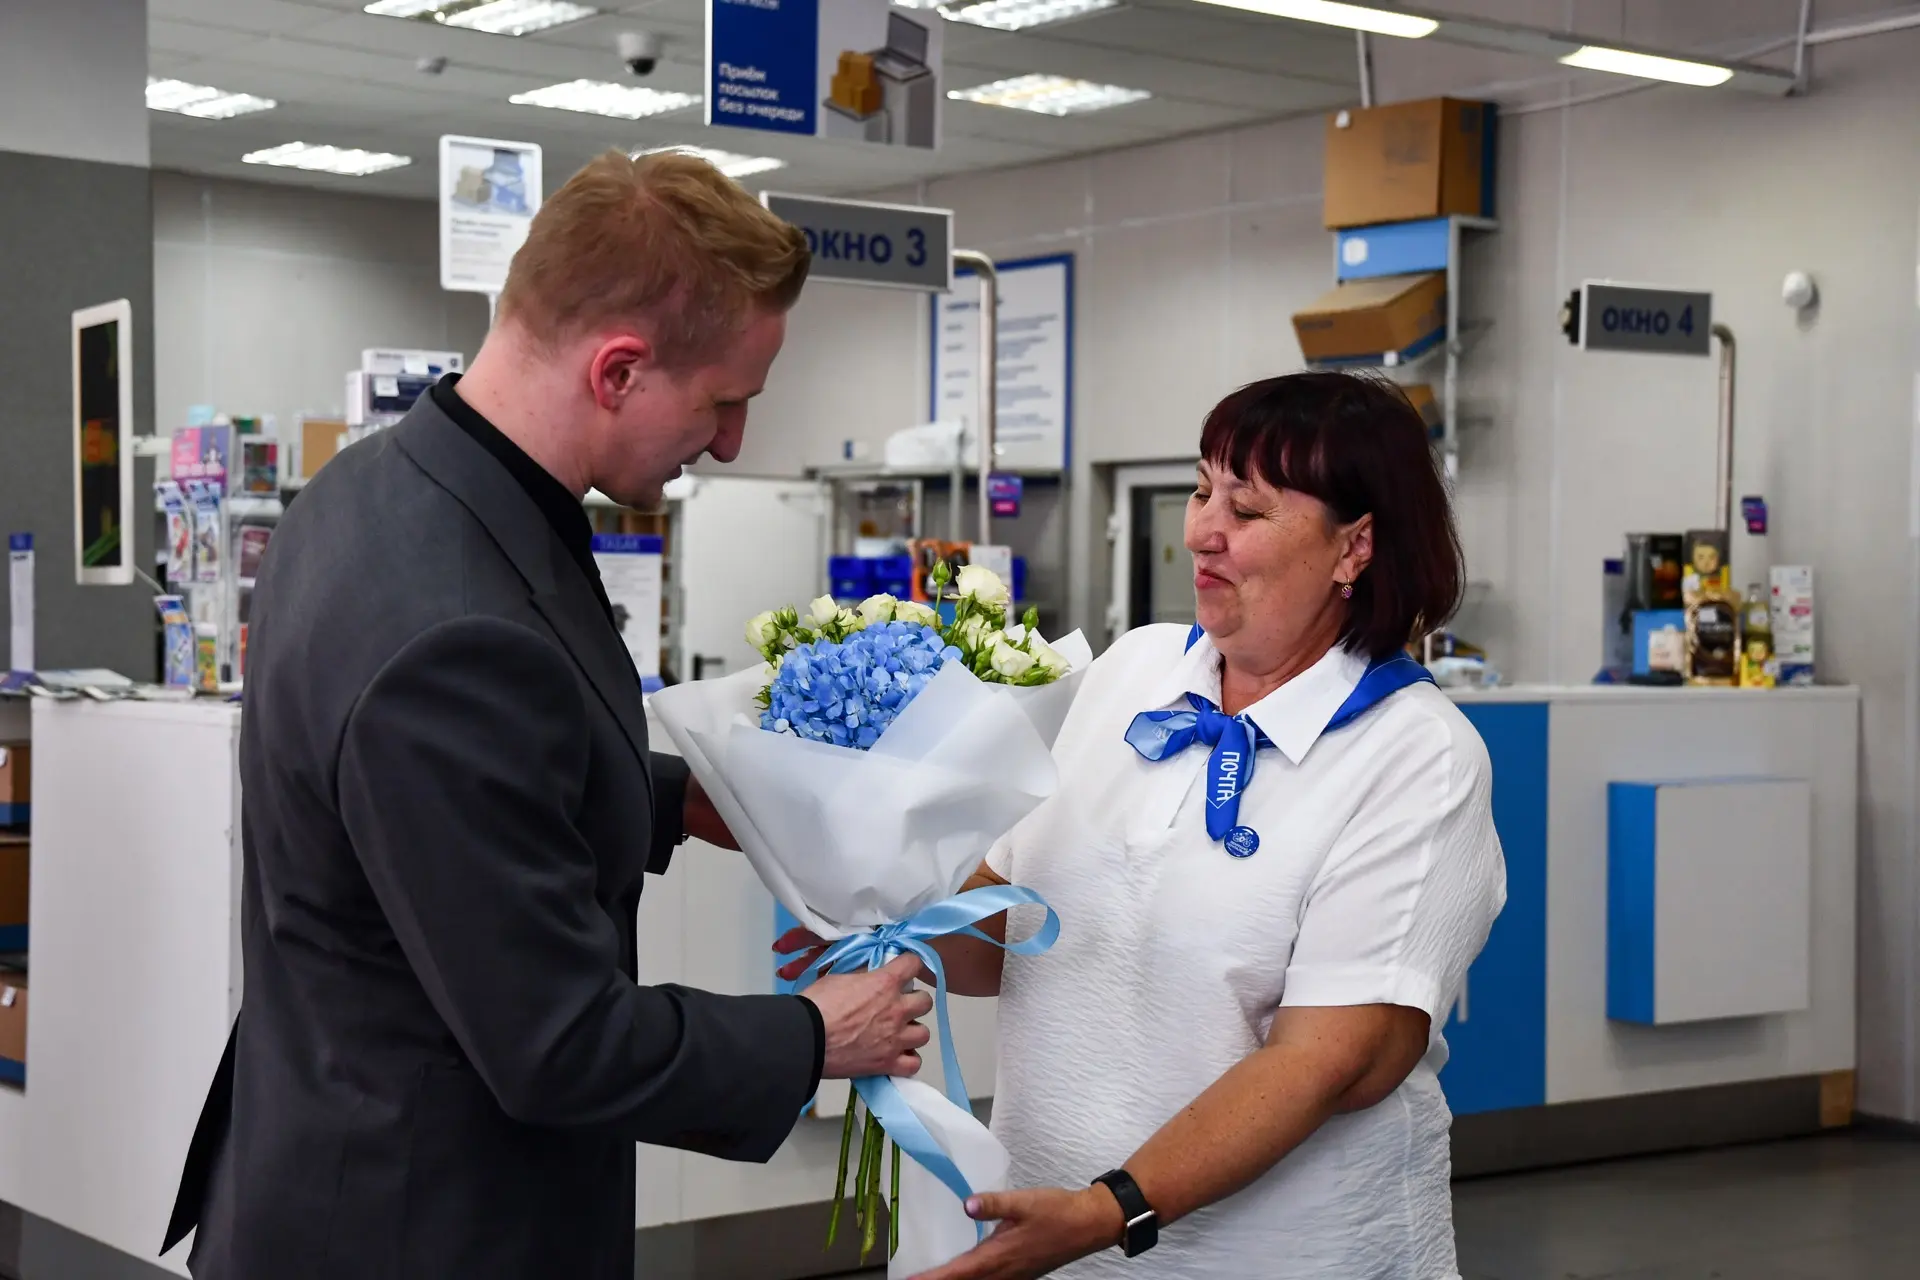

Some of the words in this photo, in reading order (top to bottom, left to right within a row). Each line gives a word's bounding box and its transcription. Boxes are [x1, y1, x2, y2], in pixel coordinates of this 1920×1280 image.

[718, 82, 778, 101] посылок
[718, 98, 744, 114] без
[745, 104, 805, 121] очереди
[905, 226, 927, 267] 3
[1602, 305, 1670, 335] ОКНО
[1677, 304, 1694, 336] 4
[1217, 751, 1241, 802] ПОЧТА
